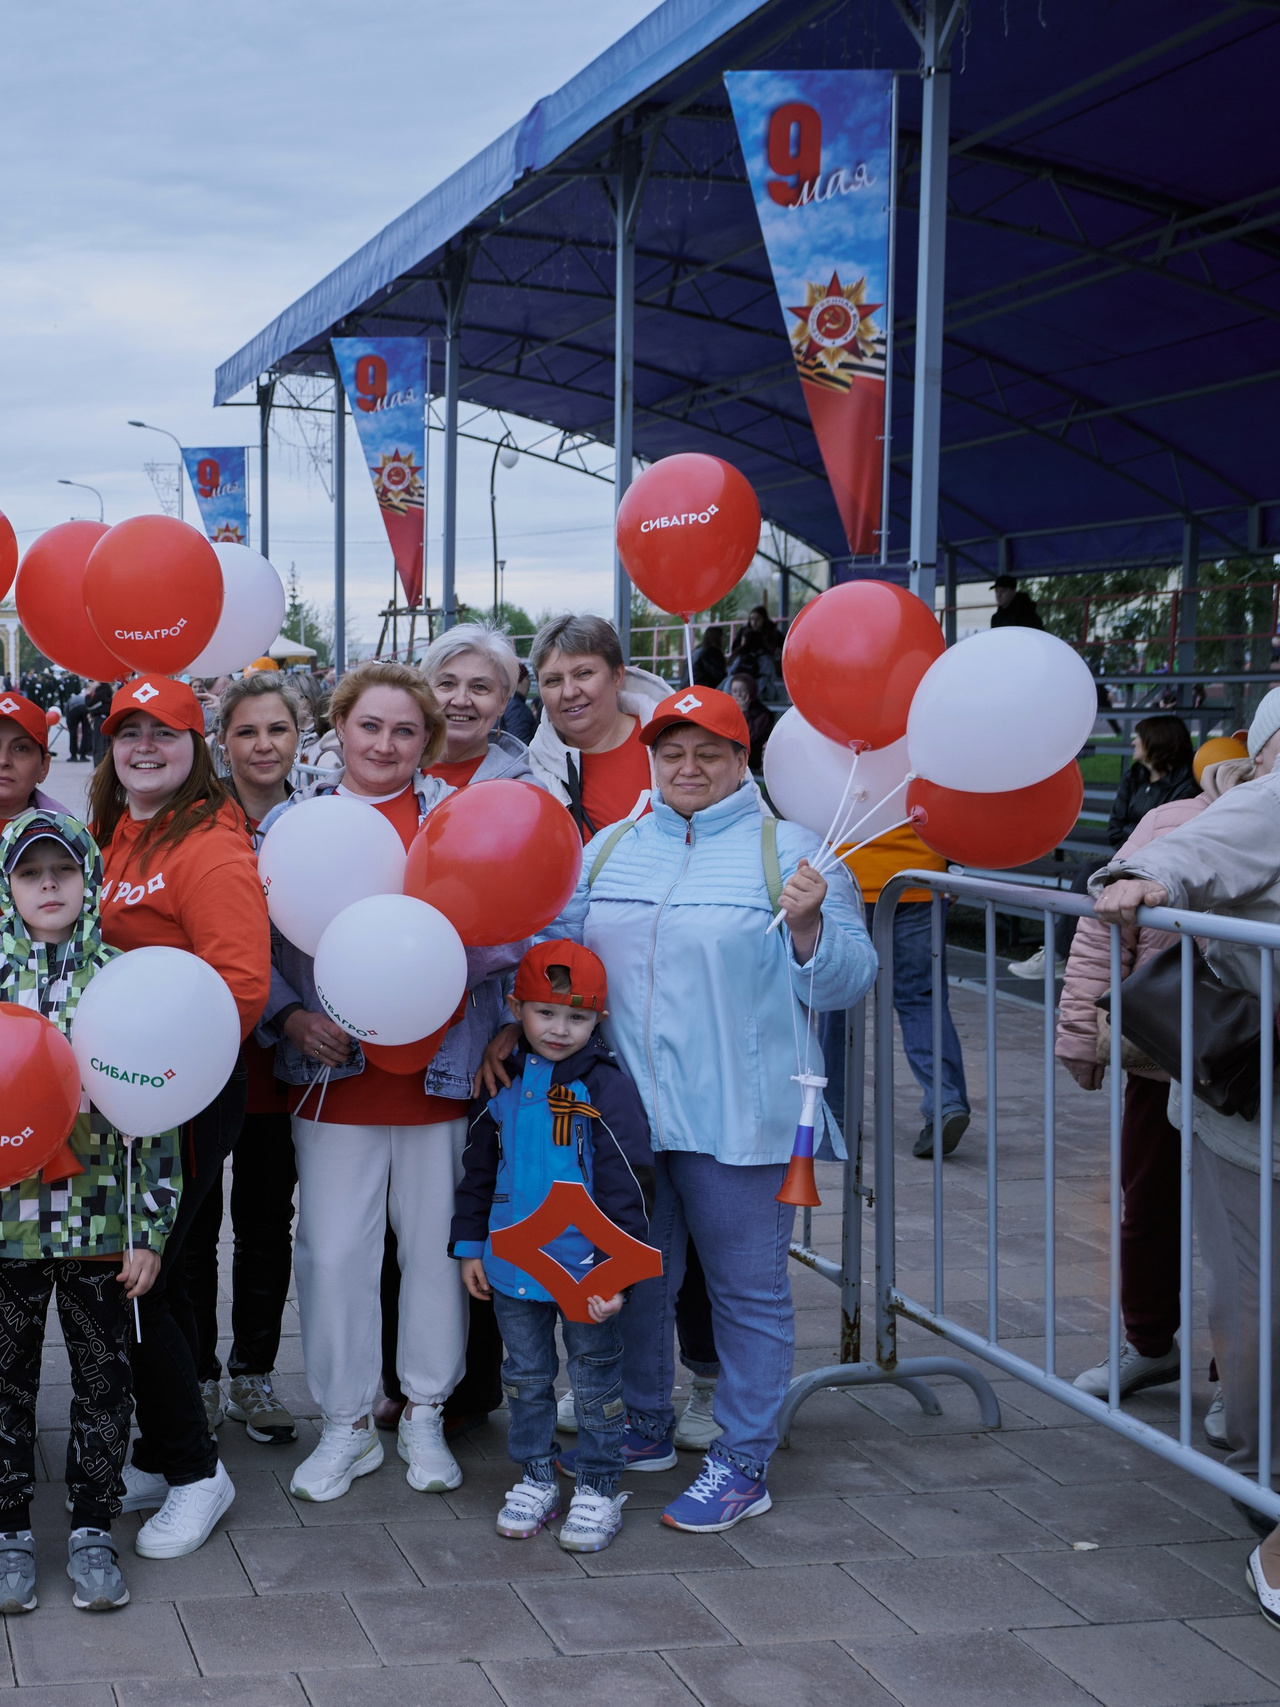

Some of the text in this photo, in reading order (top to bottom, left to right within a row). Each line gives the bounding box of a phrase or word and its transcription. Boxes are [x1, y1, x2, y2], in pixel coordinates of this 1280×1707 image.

[768, 102, 822, 209] 9
[788, 163, 878, 211] мая
[355, 354, 388, 413] 9
[369, 388, 420, 415] мая
[198, 458, 220, 499] 9
[640, 512, 711, 533] СИБАГРО
[114, 626, 181, 641] СИБАГРО
[317, 985, 369, 1038] СИБАГРО
[90, 1057, 165, 1088] СИБАГРО
